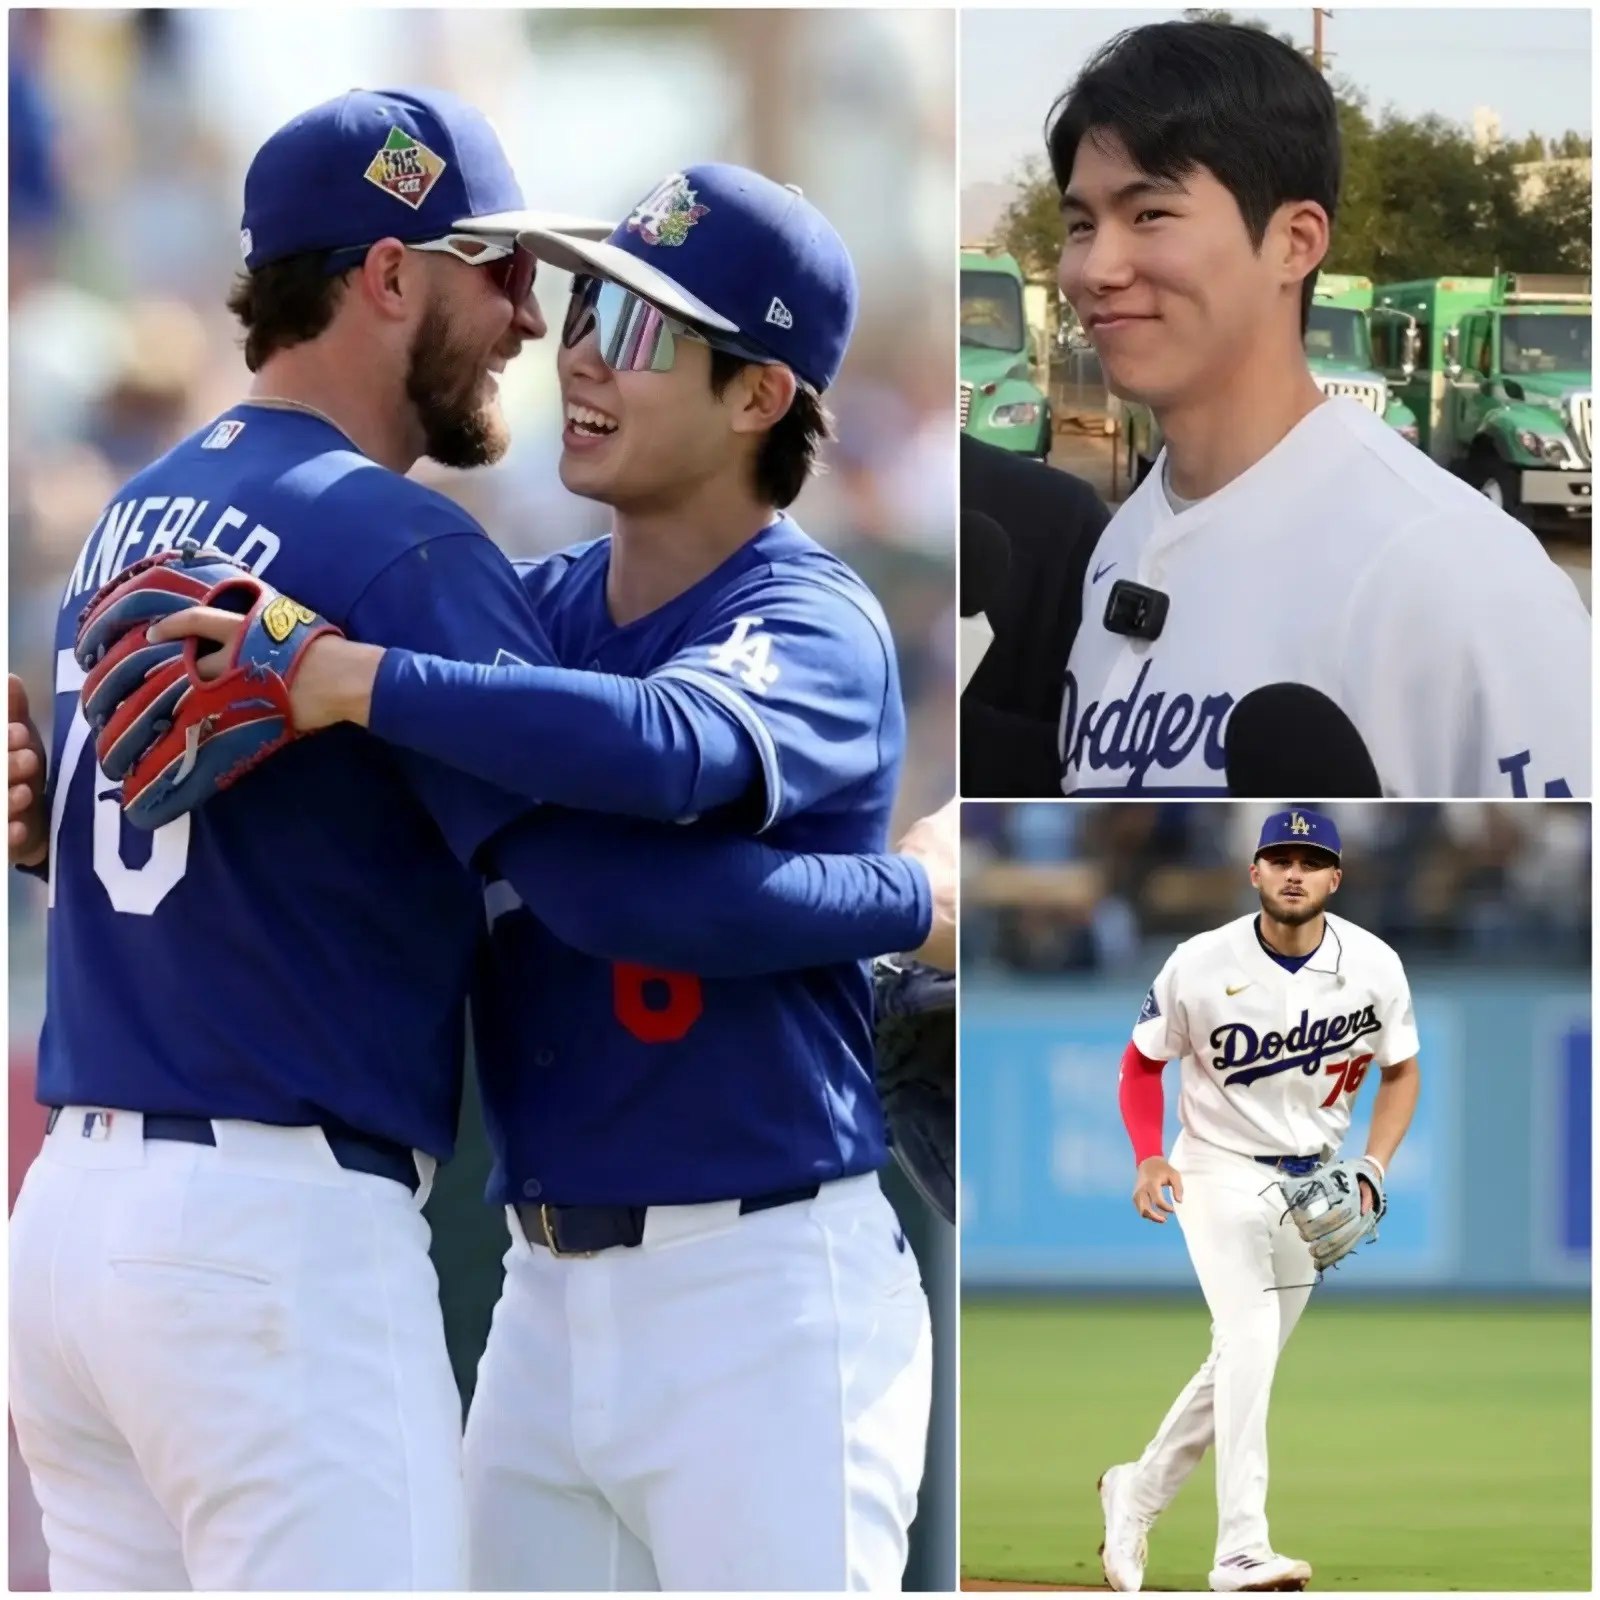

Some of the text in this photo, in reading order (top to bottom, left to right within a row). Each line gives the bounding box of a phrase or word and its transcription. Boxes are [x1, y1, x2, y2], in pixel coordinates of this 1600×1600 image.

[707, 616, 779, 696] LA
[1059, 658, 1235, 789] Dodger
[1290, 812, 1310, 836] LA
[1210, 1004, 1380, 1077] Dodgers
[1319, 1053, 1374, 1108] 76
